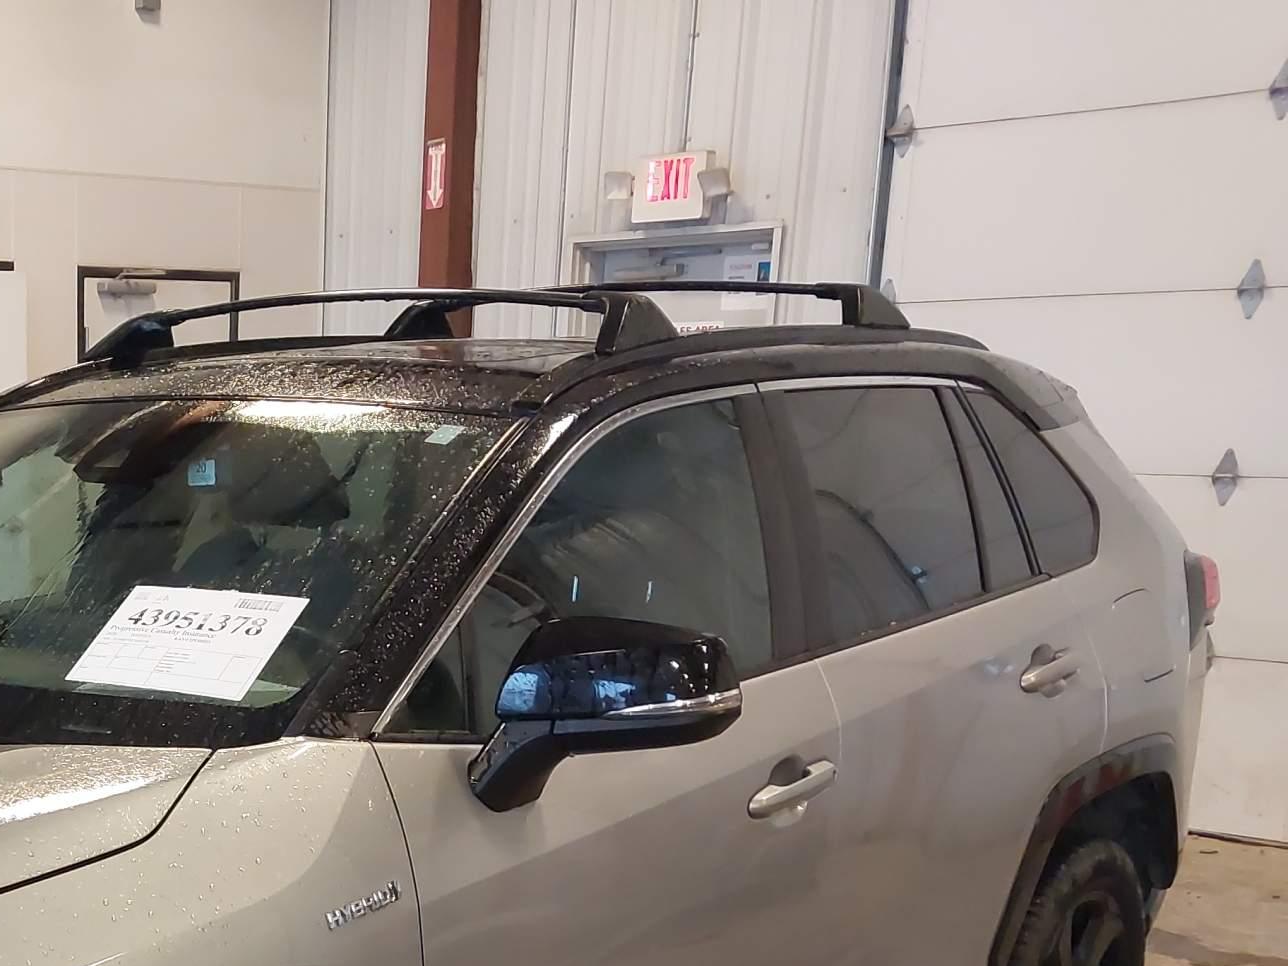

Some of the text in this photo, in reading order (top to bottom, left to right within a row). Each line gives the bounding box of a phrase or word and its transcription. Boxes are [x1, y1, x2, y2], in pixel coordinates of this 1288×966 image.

[647, 157, 695, 203] EXIT
[128, 607, 268, 636] 43951378
[325, 887, 393, 930] HYBRID
